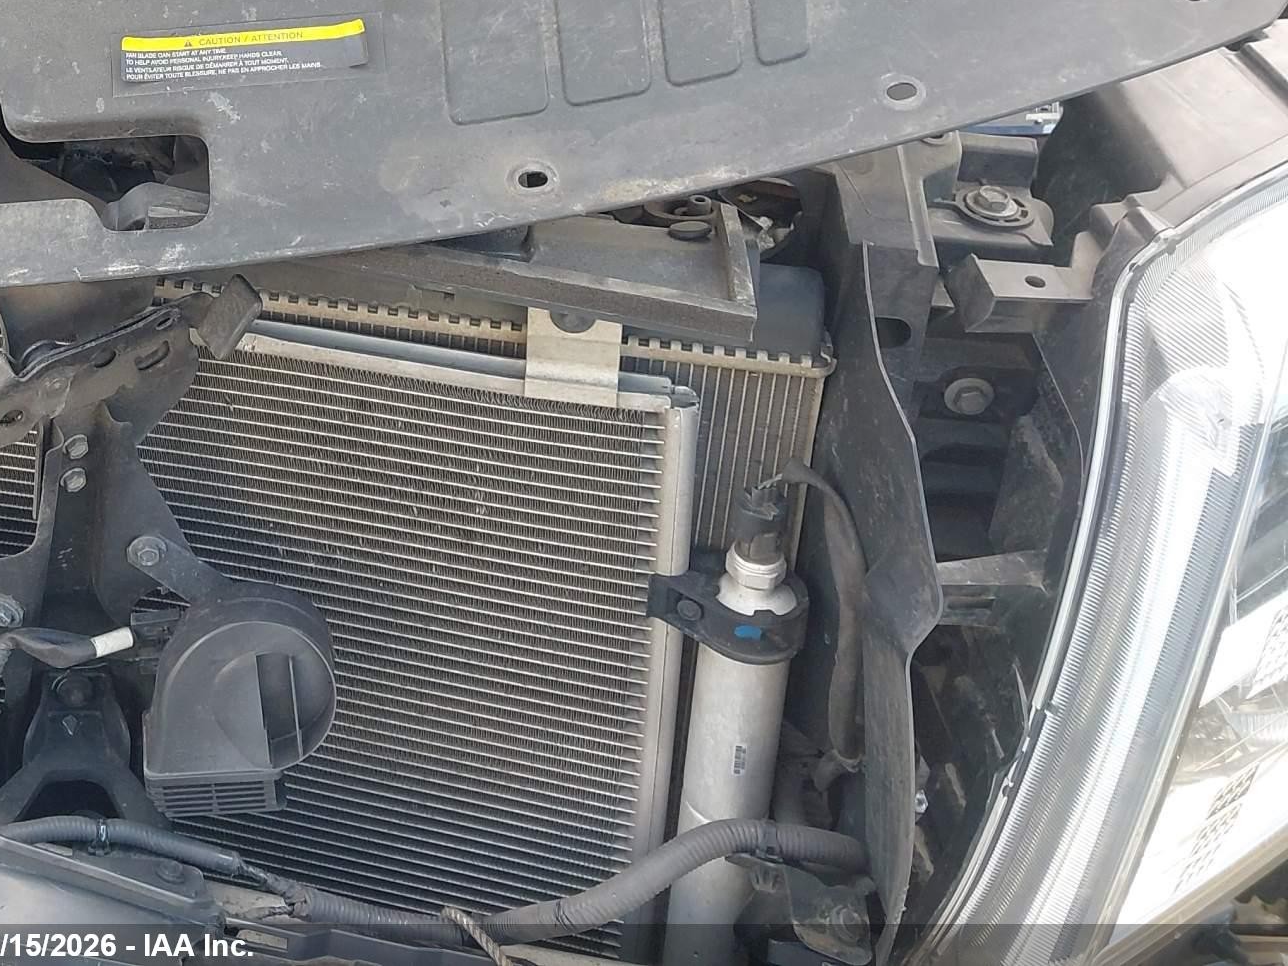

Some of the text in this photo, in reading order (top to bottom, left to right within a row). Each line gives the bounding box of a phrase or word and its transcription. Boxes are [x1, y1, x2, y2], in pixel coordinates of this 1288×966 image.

[199, 36, 240, 46] CAUTION
[251, 32, 303, 42] ATTENTION
[170, 56, 202, 64] PERSONAL
[205, 60, 238, 69] DÉMARRER
[144, 72, 164, 80] ÉVITER
[250, 64, 288, 72] APPROCHER
